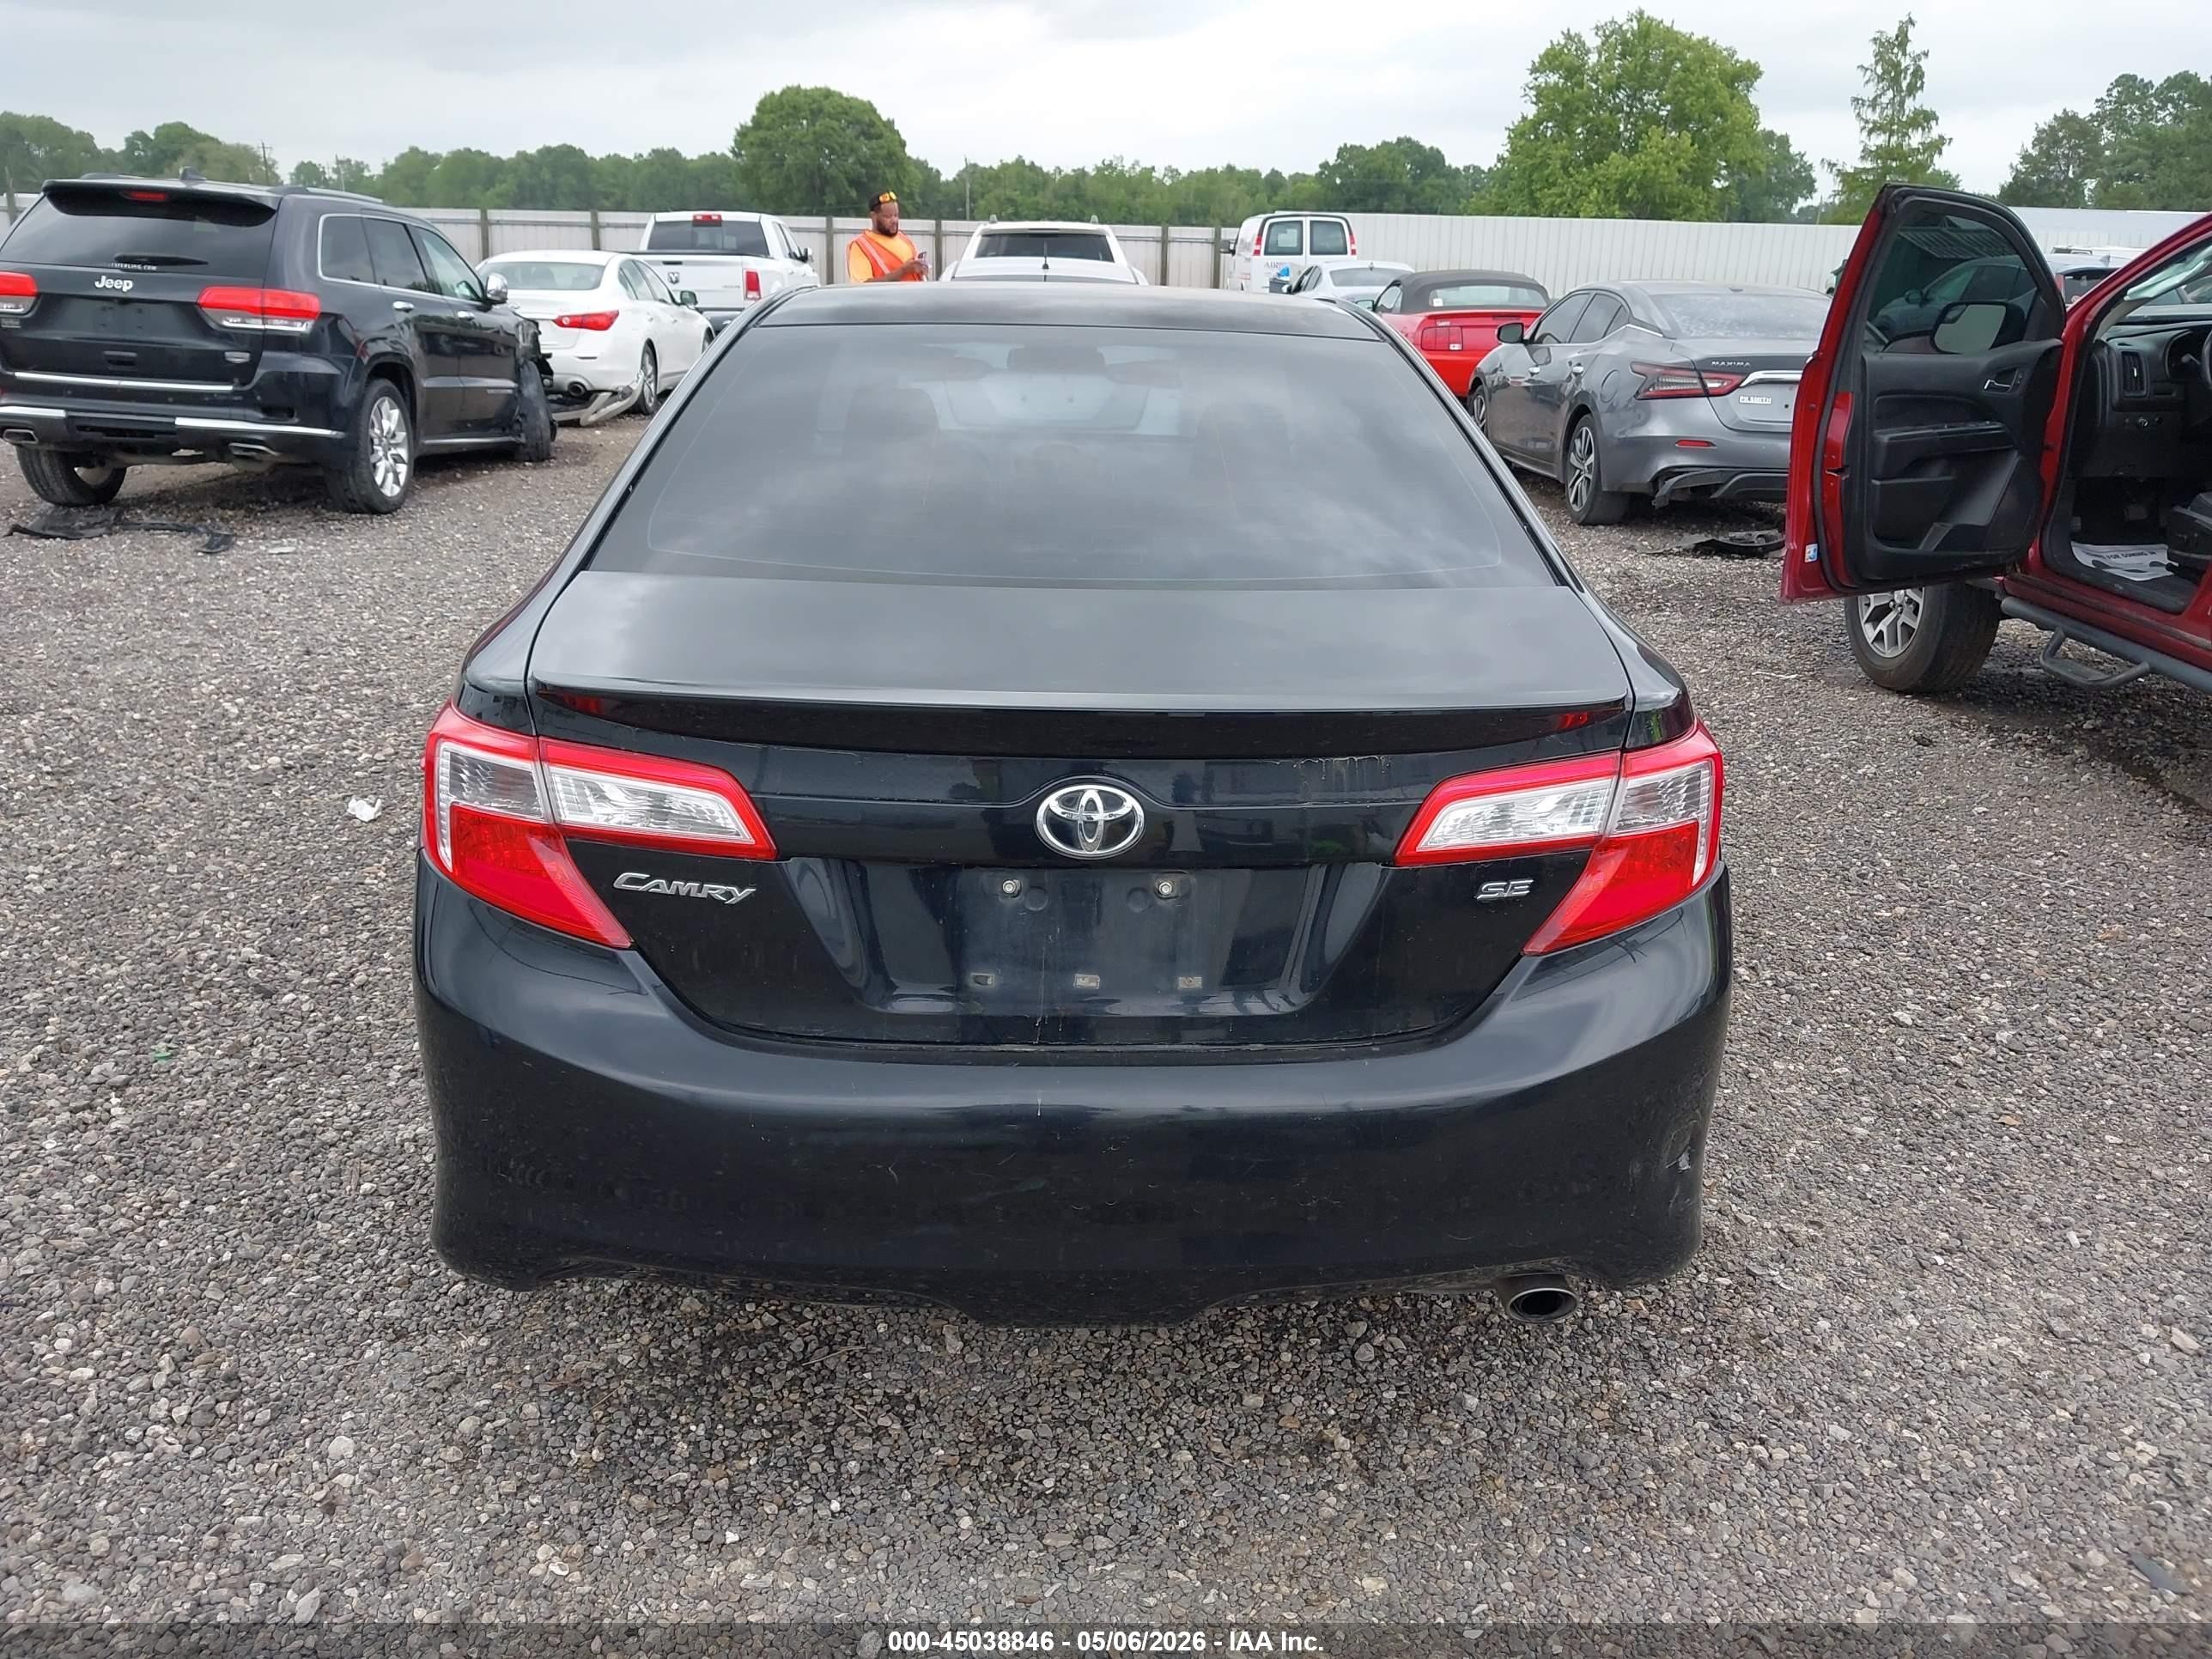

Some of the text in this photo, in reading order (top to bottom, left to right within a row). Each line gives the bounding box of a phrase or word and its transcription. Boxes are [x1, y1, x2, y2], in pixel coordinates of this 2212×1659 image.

[94, 275, 134, 293] Jeep
[612, 872, 757, 904] CAMRY
[1475, 879, 1534, 901] SE
